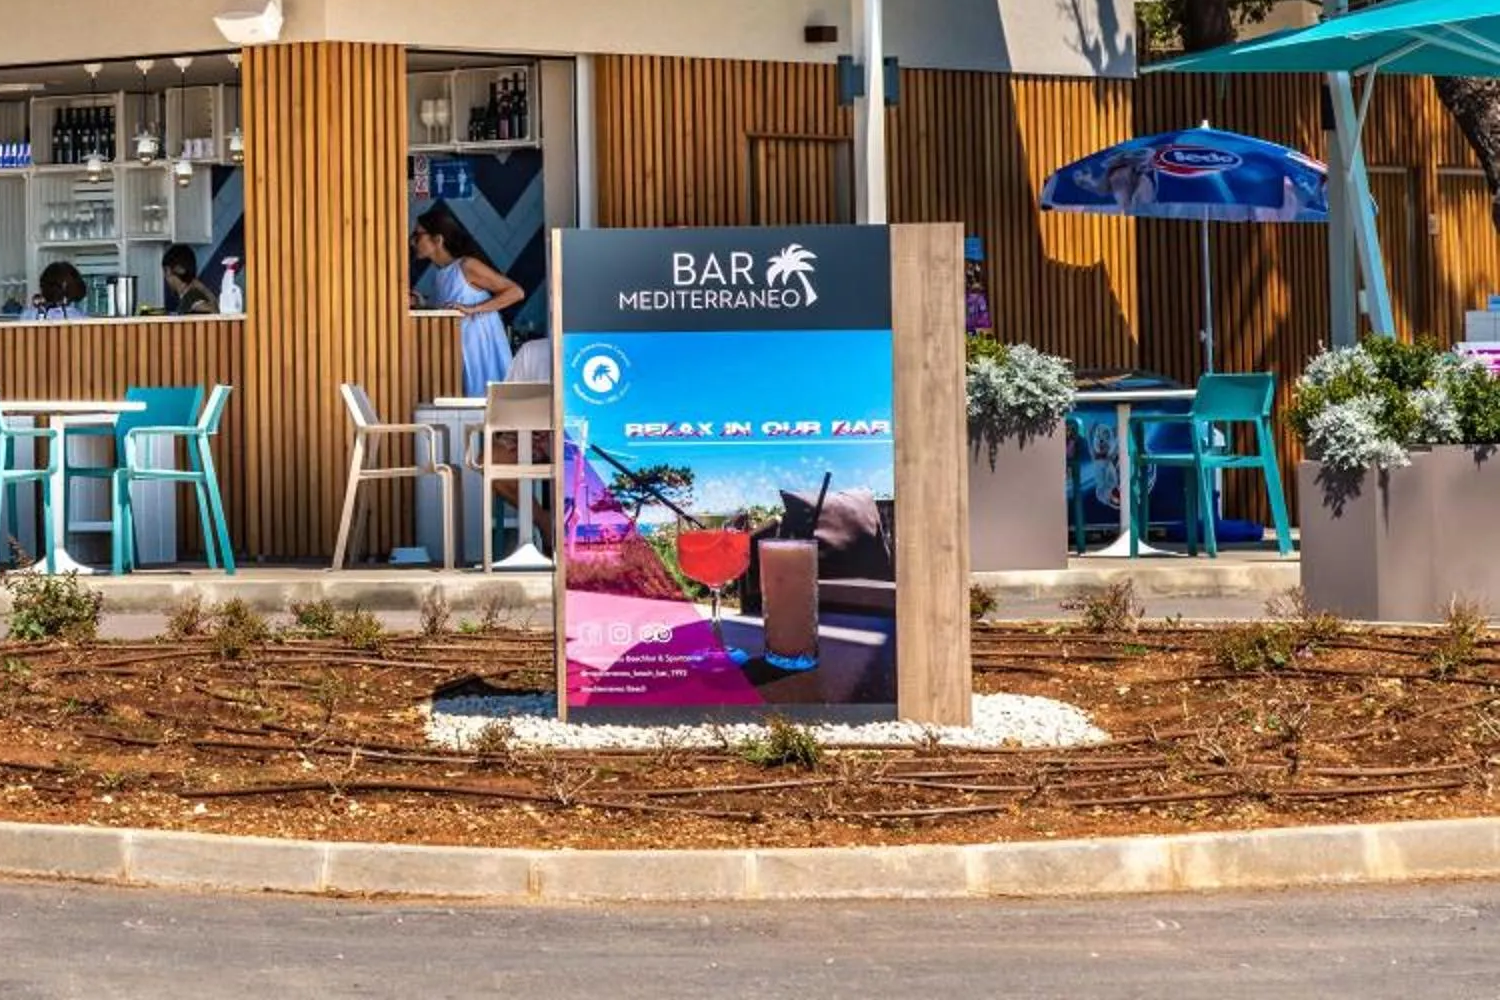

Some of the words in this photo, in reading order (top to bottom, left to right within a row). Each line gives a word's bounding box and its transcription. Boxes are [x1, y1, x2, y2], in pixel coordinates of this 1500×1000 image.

[672, 252, 754, 286] BAR
[619, 289, 801, 310] MEDITERRANEO
[624, 422, 714, 437] RELAX
[723, 421, 752, 436] IN
[761, 420, 822, 436] OUR
[831, 420, 891, 435] BAR
